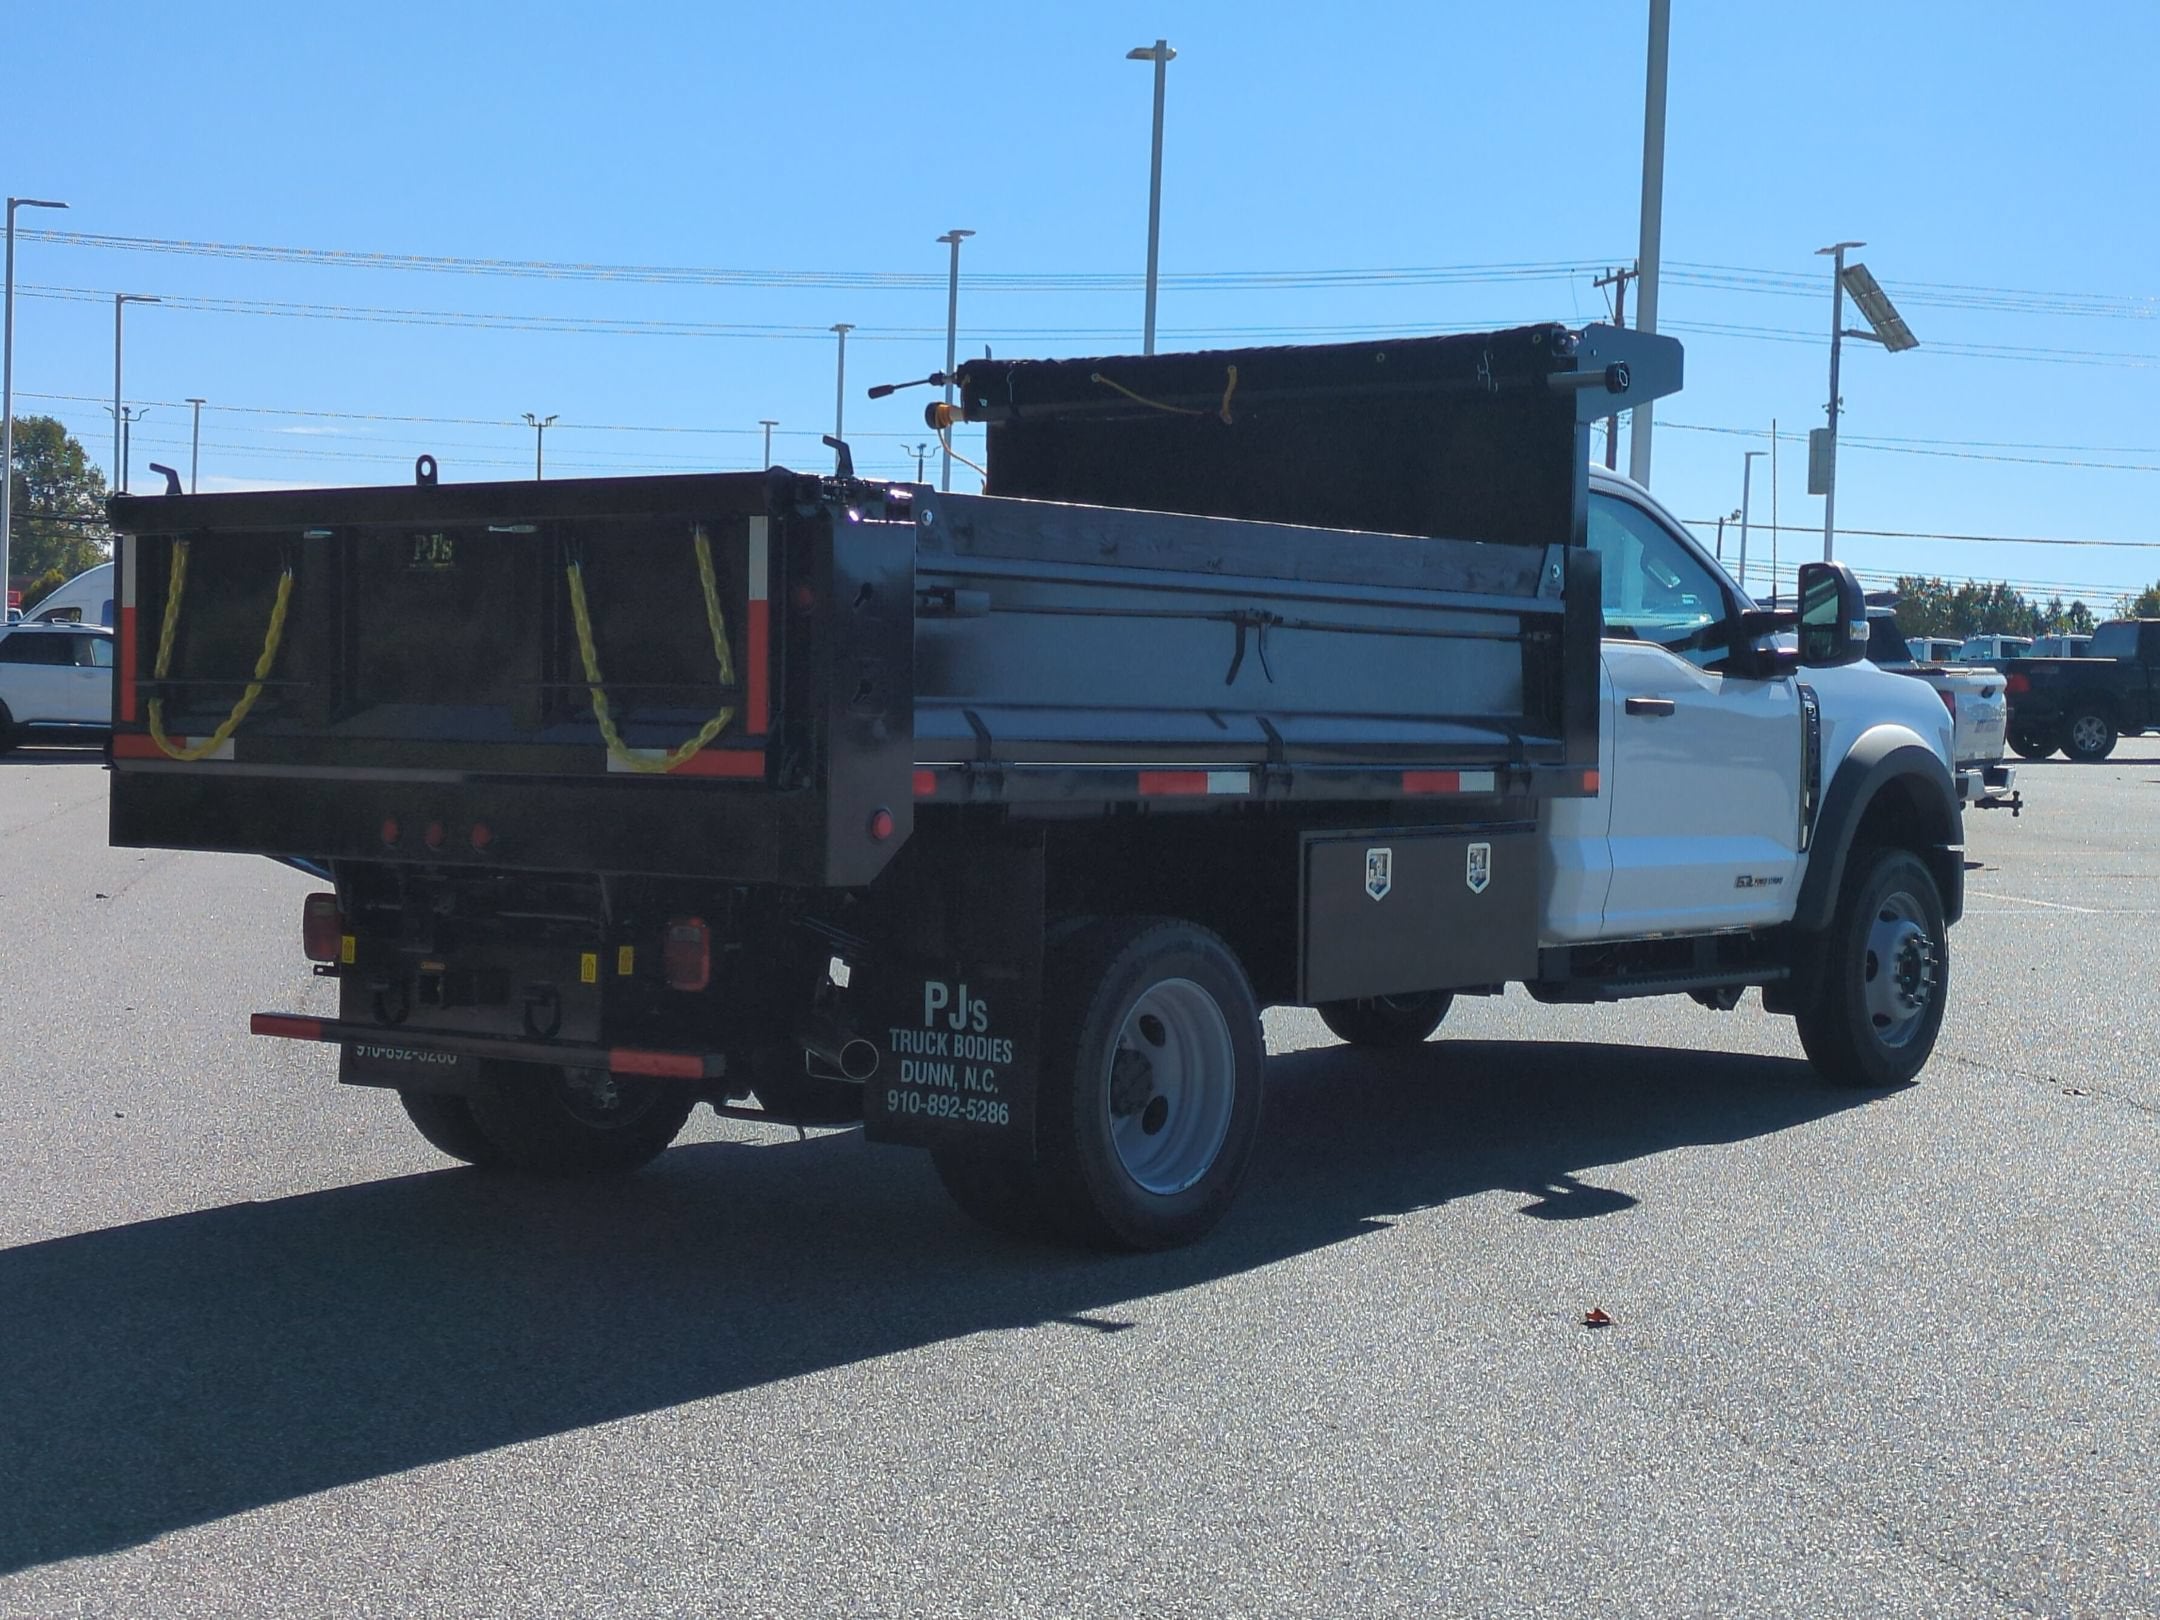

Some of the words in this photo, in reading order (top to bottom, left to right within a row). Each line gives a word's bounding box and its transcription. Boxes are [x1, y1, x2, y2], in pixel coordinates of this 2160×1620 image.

[925, 981, 988, 1032] PJ's
[890, 1028, 948, 1056] TRUCK
[955, 1035, 1013, 1064] BODIES
[902, 1060, 959, 1092] DUNN,
[965, 1066, 999, 1093] N.C.
[888, 1089, 1009, 1125] 910-892-5286
